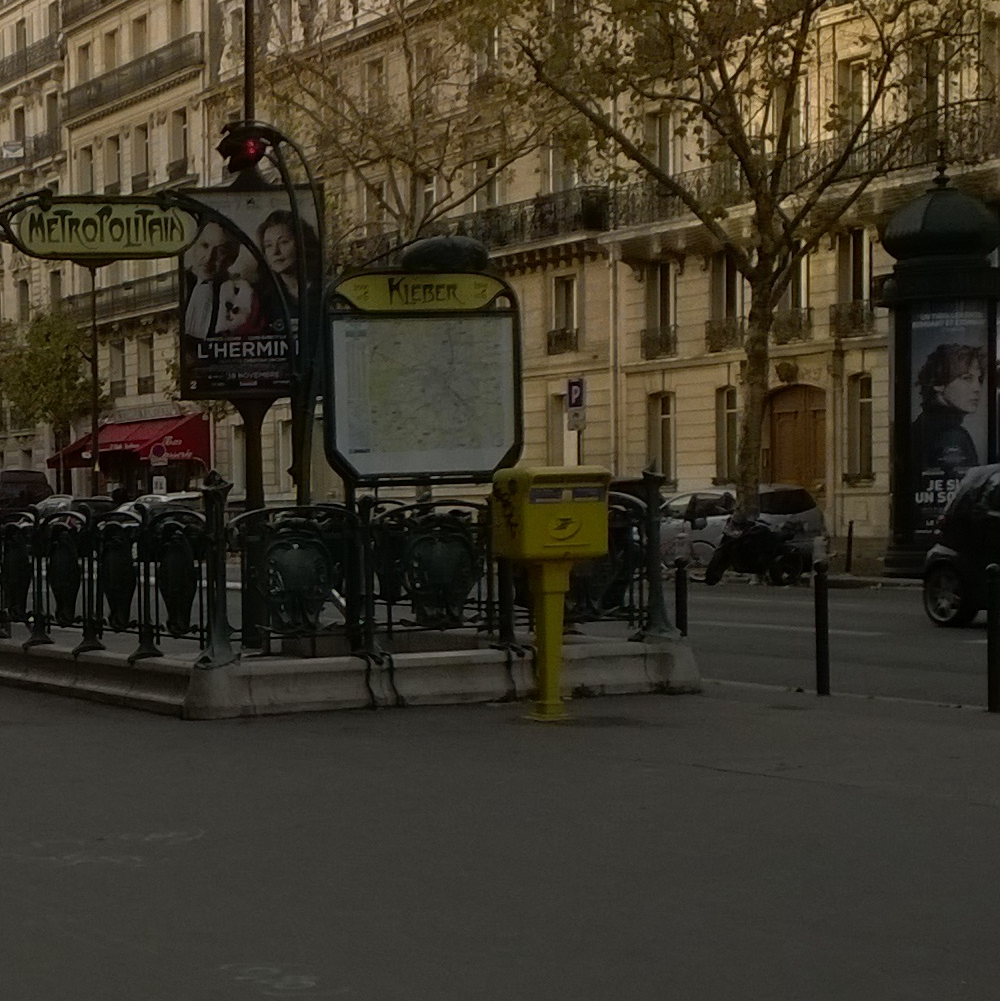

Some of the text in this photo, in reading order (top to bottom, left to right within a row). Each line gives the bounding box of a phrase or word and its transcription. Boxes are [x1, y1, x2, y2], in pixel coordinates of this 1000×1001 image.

[28, 205, 185, 249] METROPOLITAIN
[387, 277, 466, 305] KLEBER
[197, 340, 300, 359] L'HERMIN
[571, 385, 581, 404] P
[926, 479, 944, 492] JE
[915, 491, 934, 504] UN
